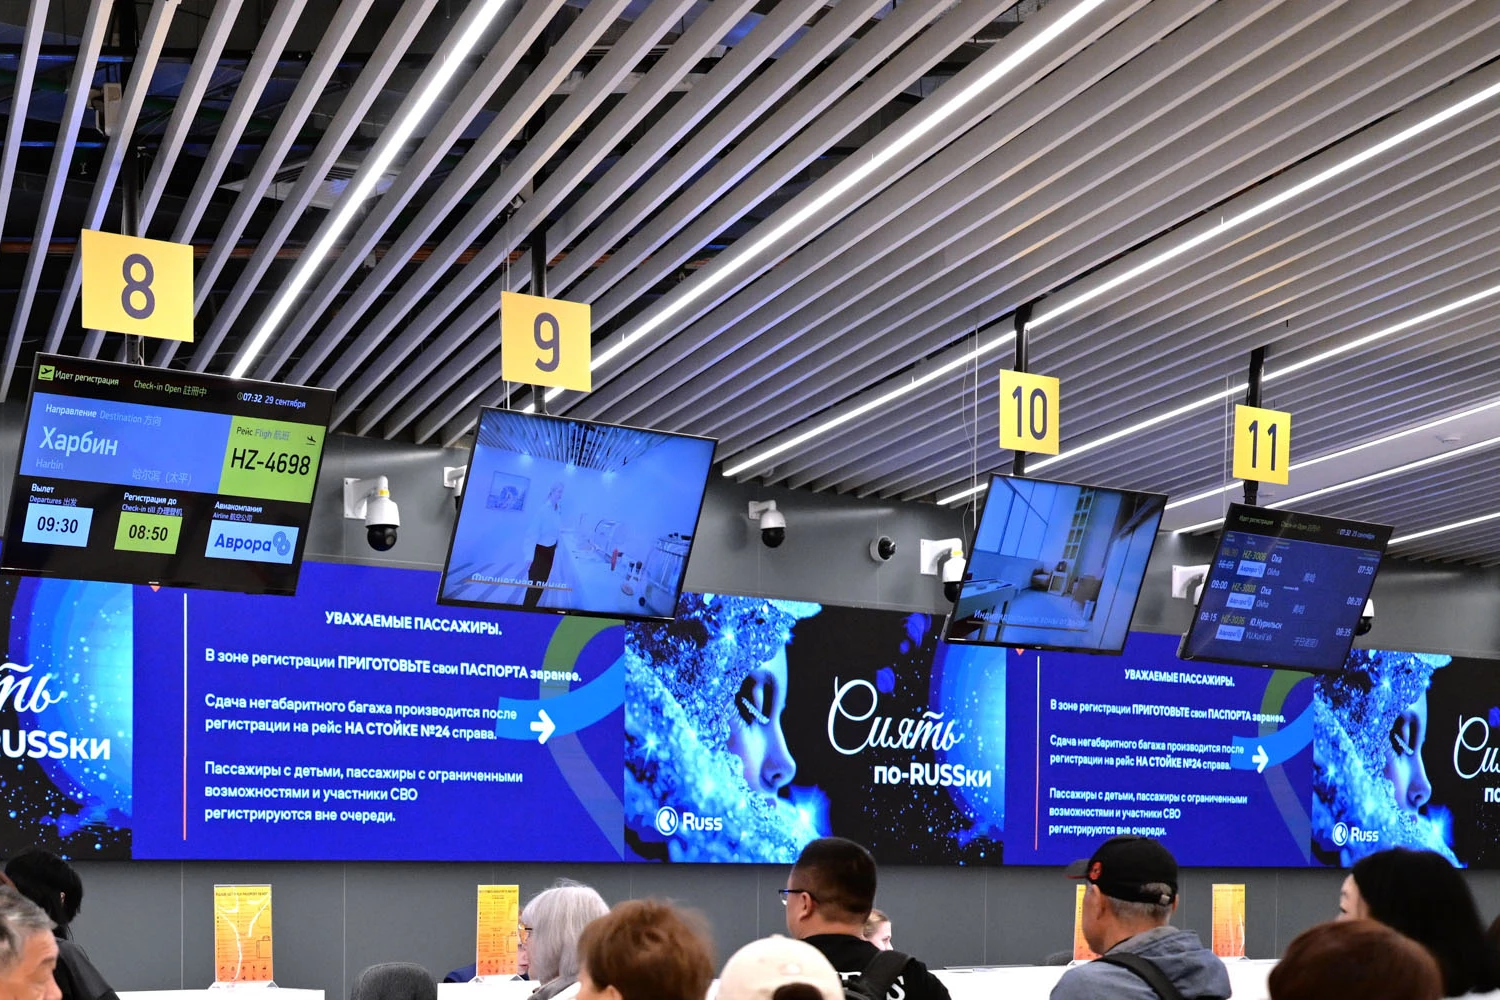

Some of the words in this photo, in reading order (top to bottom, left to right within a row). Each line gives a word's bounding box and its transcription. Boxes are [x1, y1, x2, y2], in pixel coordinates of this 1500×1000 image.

[121, 253, 155, 319] 8
[533, 312, 560, 372] 9
[55, 369, 73, 380] Идет
[75, 375, 119, 385] регистрация
[134, 380, 163, 390] Check-in
[165, 384, 181, 393] Open
[243, 393, 262, 402] 07:32
[265, 396, 274, 404] 29
[275, 399, 306, 408] сентября
[46, 404, 97, 417] Направление
[1012, 385, 1048, 441] 10
[39, 426, 118, 456] Харбин
[1248, 419, 1277, 473] 11
[231, 448, 310, 475] HZ-4698
[32, 484, 54, 493] Вылет
[124, 492, 167, 504] Регистрация
[215, 501, 262, 513] Авиакомпания
[38, 517, 78, 533] 09:30
[129, 525, 168, 541] 08:50
[214, 533, 272, 554] Аврора
[325, 611, 412, 629] УВАЖАЕМЫЕ
[415, 617, 502, 635] ПАССАЖИРЫ.
[206, 648, 214, 661] В
[218, 652, 249, 663] зоне
[252, 654, 335, 669] регистрации
[338, 656, 430, 673] ПРИГОТОВЬТЕ
[432, 664, 458, 674] свои
[461, 663, 528, 678] ПАСПОРТА
[530, 670, 581, 683] заранее.
[1125, 669, 1178, 682] УВАЖАЕМЫЕ
[1180, 673, 1235, 686] ПАССАЖИРЫ.
[874, 763, 991, 787] по-RUSSки
[205, 787, 309, 798] возможностями
[313, 789, 320, 798] и
[323, 789, 387, 802] участники
[390, 788, 418, 800] СВО
[1049, 825, 1115, 836] регистрируются
[1117, 827, 1131, 835] вне
[1132, 827, 1166, 837] очереди.
